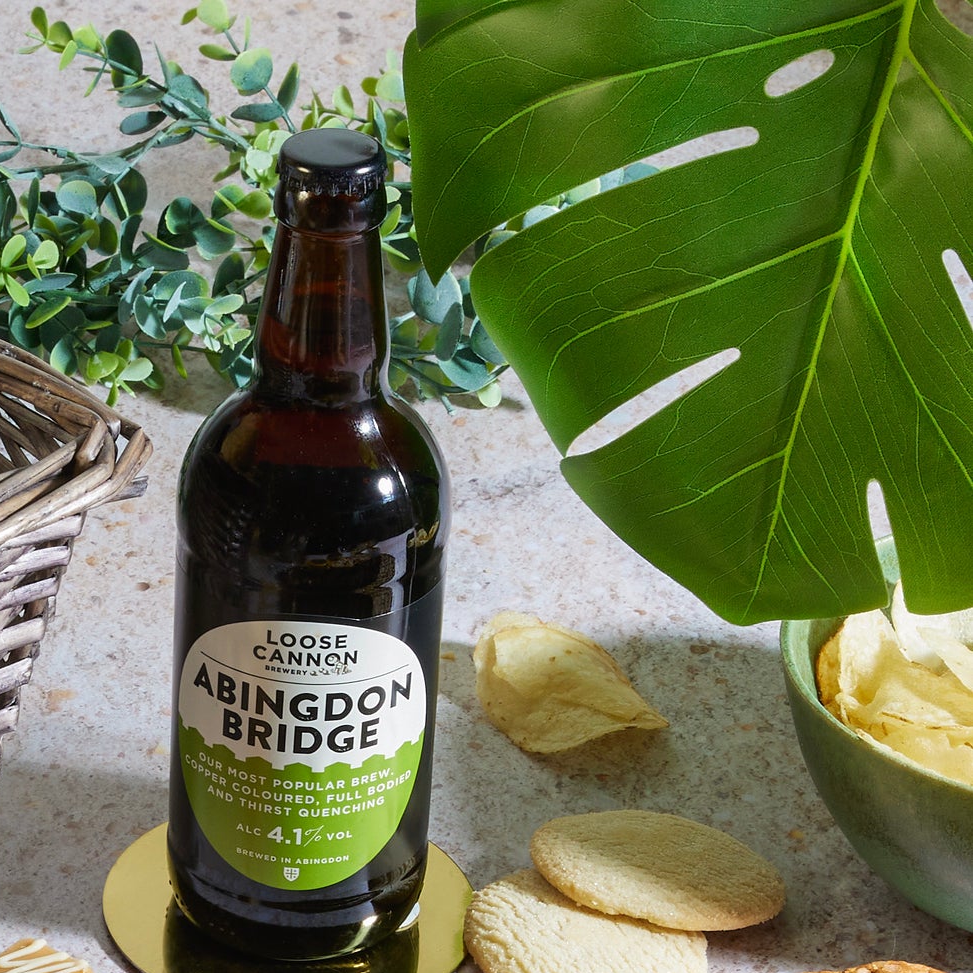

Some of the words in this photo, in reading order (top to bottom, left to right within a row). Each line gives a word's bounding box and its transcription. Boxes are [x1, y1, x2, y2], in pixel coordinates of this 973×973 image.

[266, 630, 348, 649] LOOSE
[252, 645, 358, 667] CANNON
[265, 665, 308, 676] BREWERY
[193, 662, 412, 722] ABINGDON
[222, 708, 380, 755] BRIDGE
[185, 754, 227, 786] COPPER
[231, 782, 320, 805] COLOURED,
[326, 790, 362, 804] FULL
[367, 769, 411, 796] BODIED
[198, 752, 223, 771] OUR
[228, 766, 267, 785] MOST
[273, 779, 345, 791] POPULAR
[351, 767, 394, 787] BREW.
[207, 785, 233, 802] AND
[239, 797, 292, 816] THIRST
[298, 796, 385, 817] QUENCHING
[236, 823, 262, 836] ALC
[267, 824, 325, 847] 4.1%
[327, 830, 353, 841] VOL
[236, 847, 277, 862] BREWED
[295, 855, 349, 865] ABINGDON
